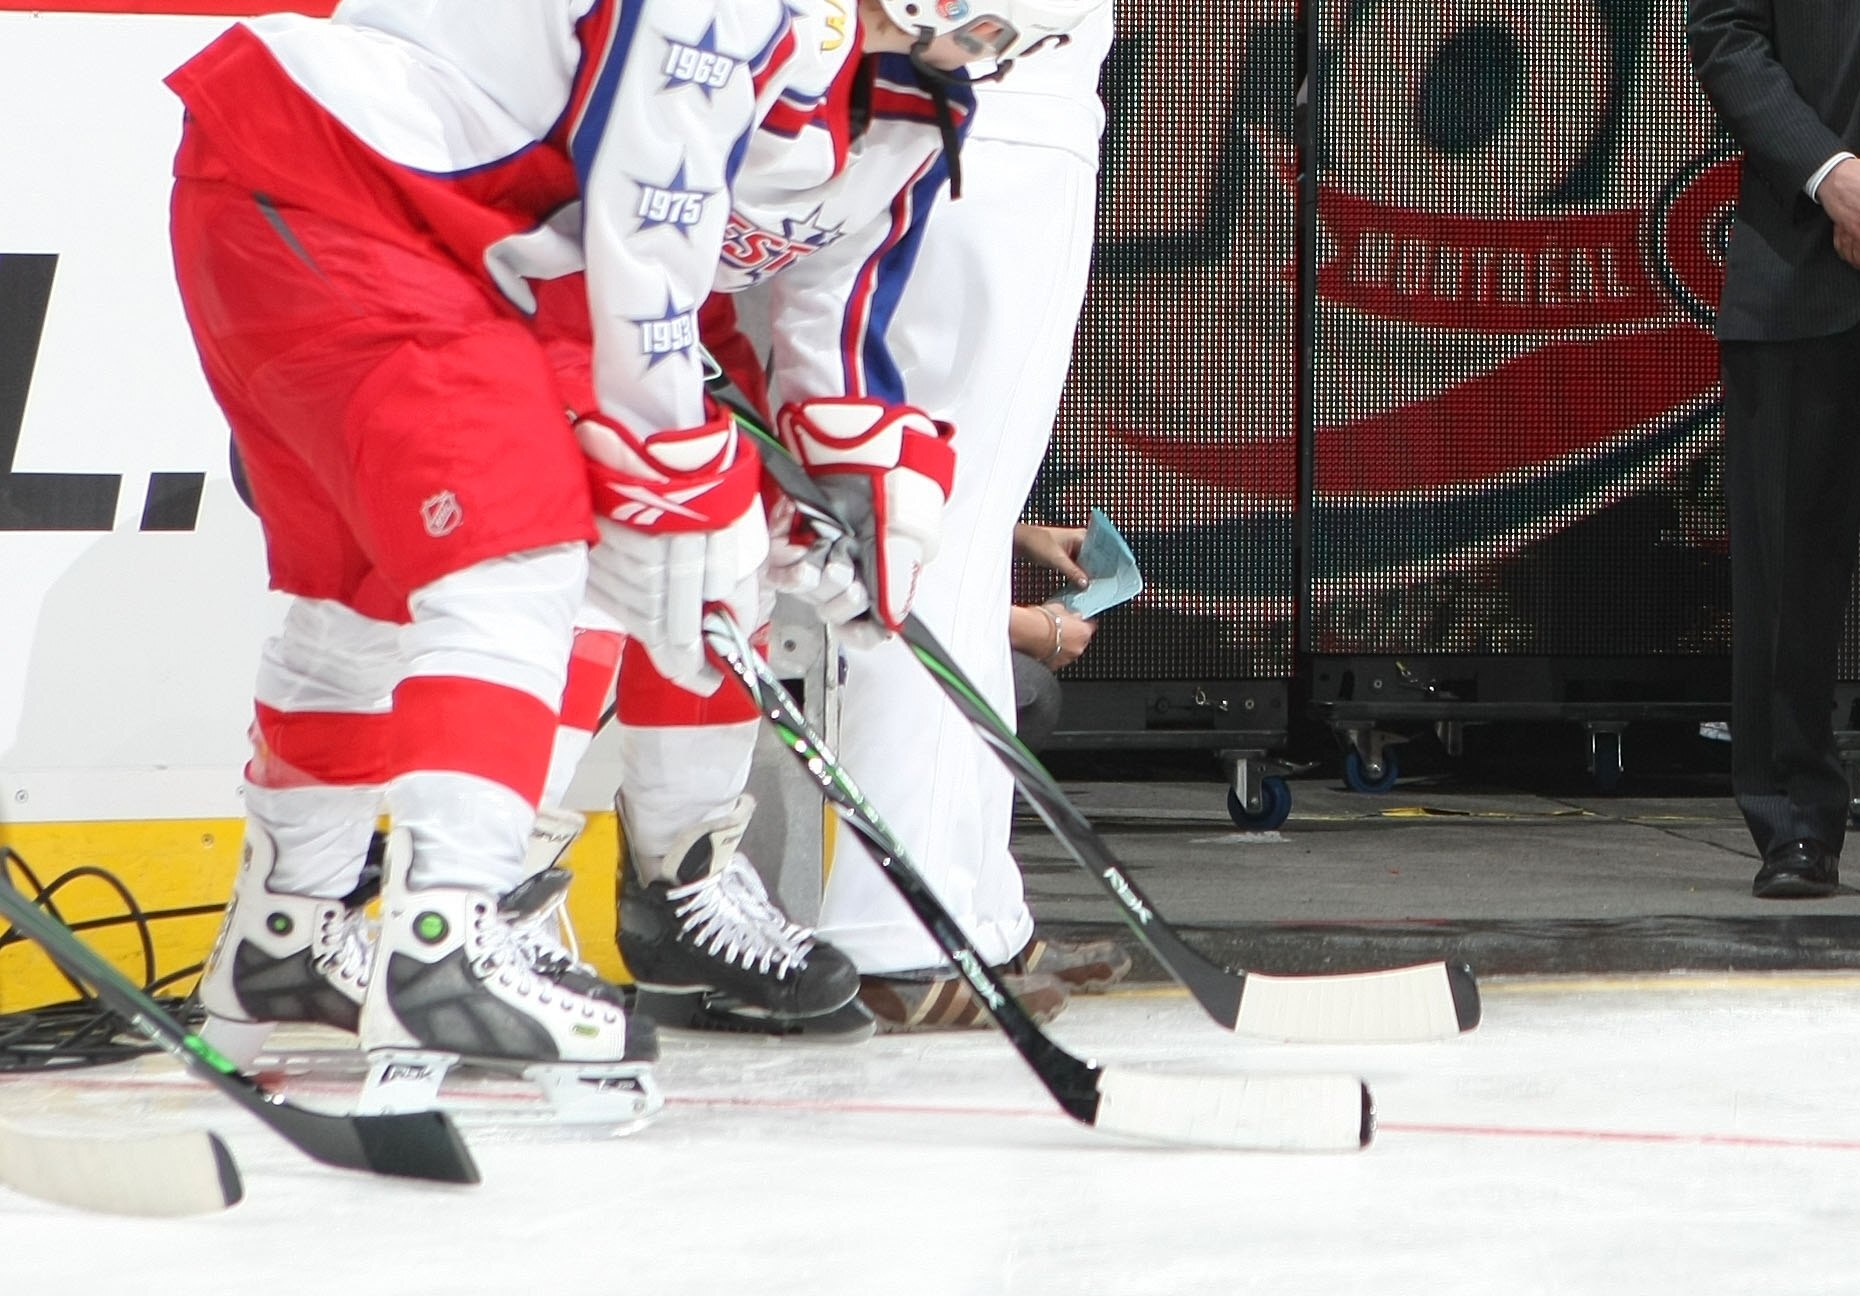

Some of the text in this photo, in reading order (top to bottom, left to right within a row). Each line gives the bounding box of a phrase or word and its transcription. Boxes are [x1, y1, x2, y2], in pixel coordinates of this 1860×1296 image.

[664, 43, 734, 90] 1969
[638, 186, 705, 225] 1975
[1347, 228, 1636, 302] MONTRÉAL
